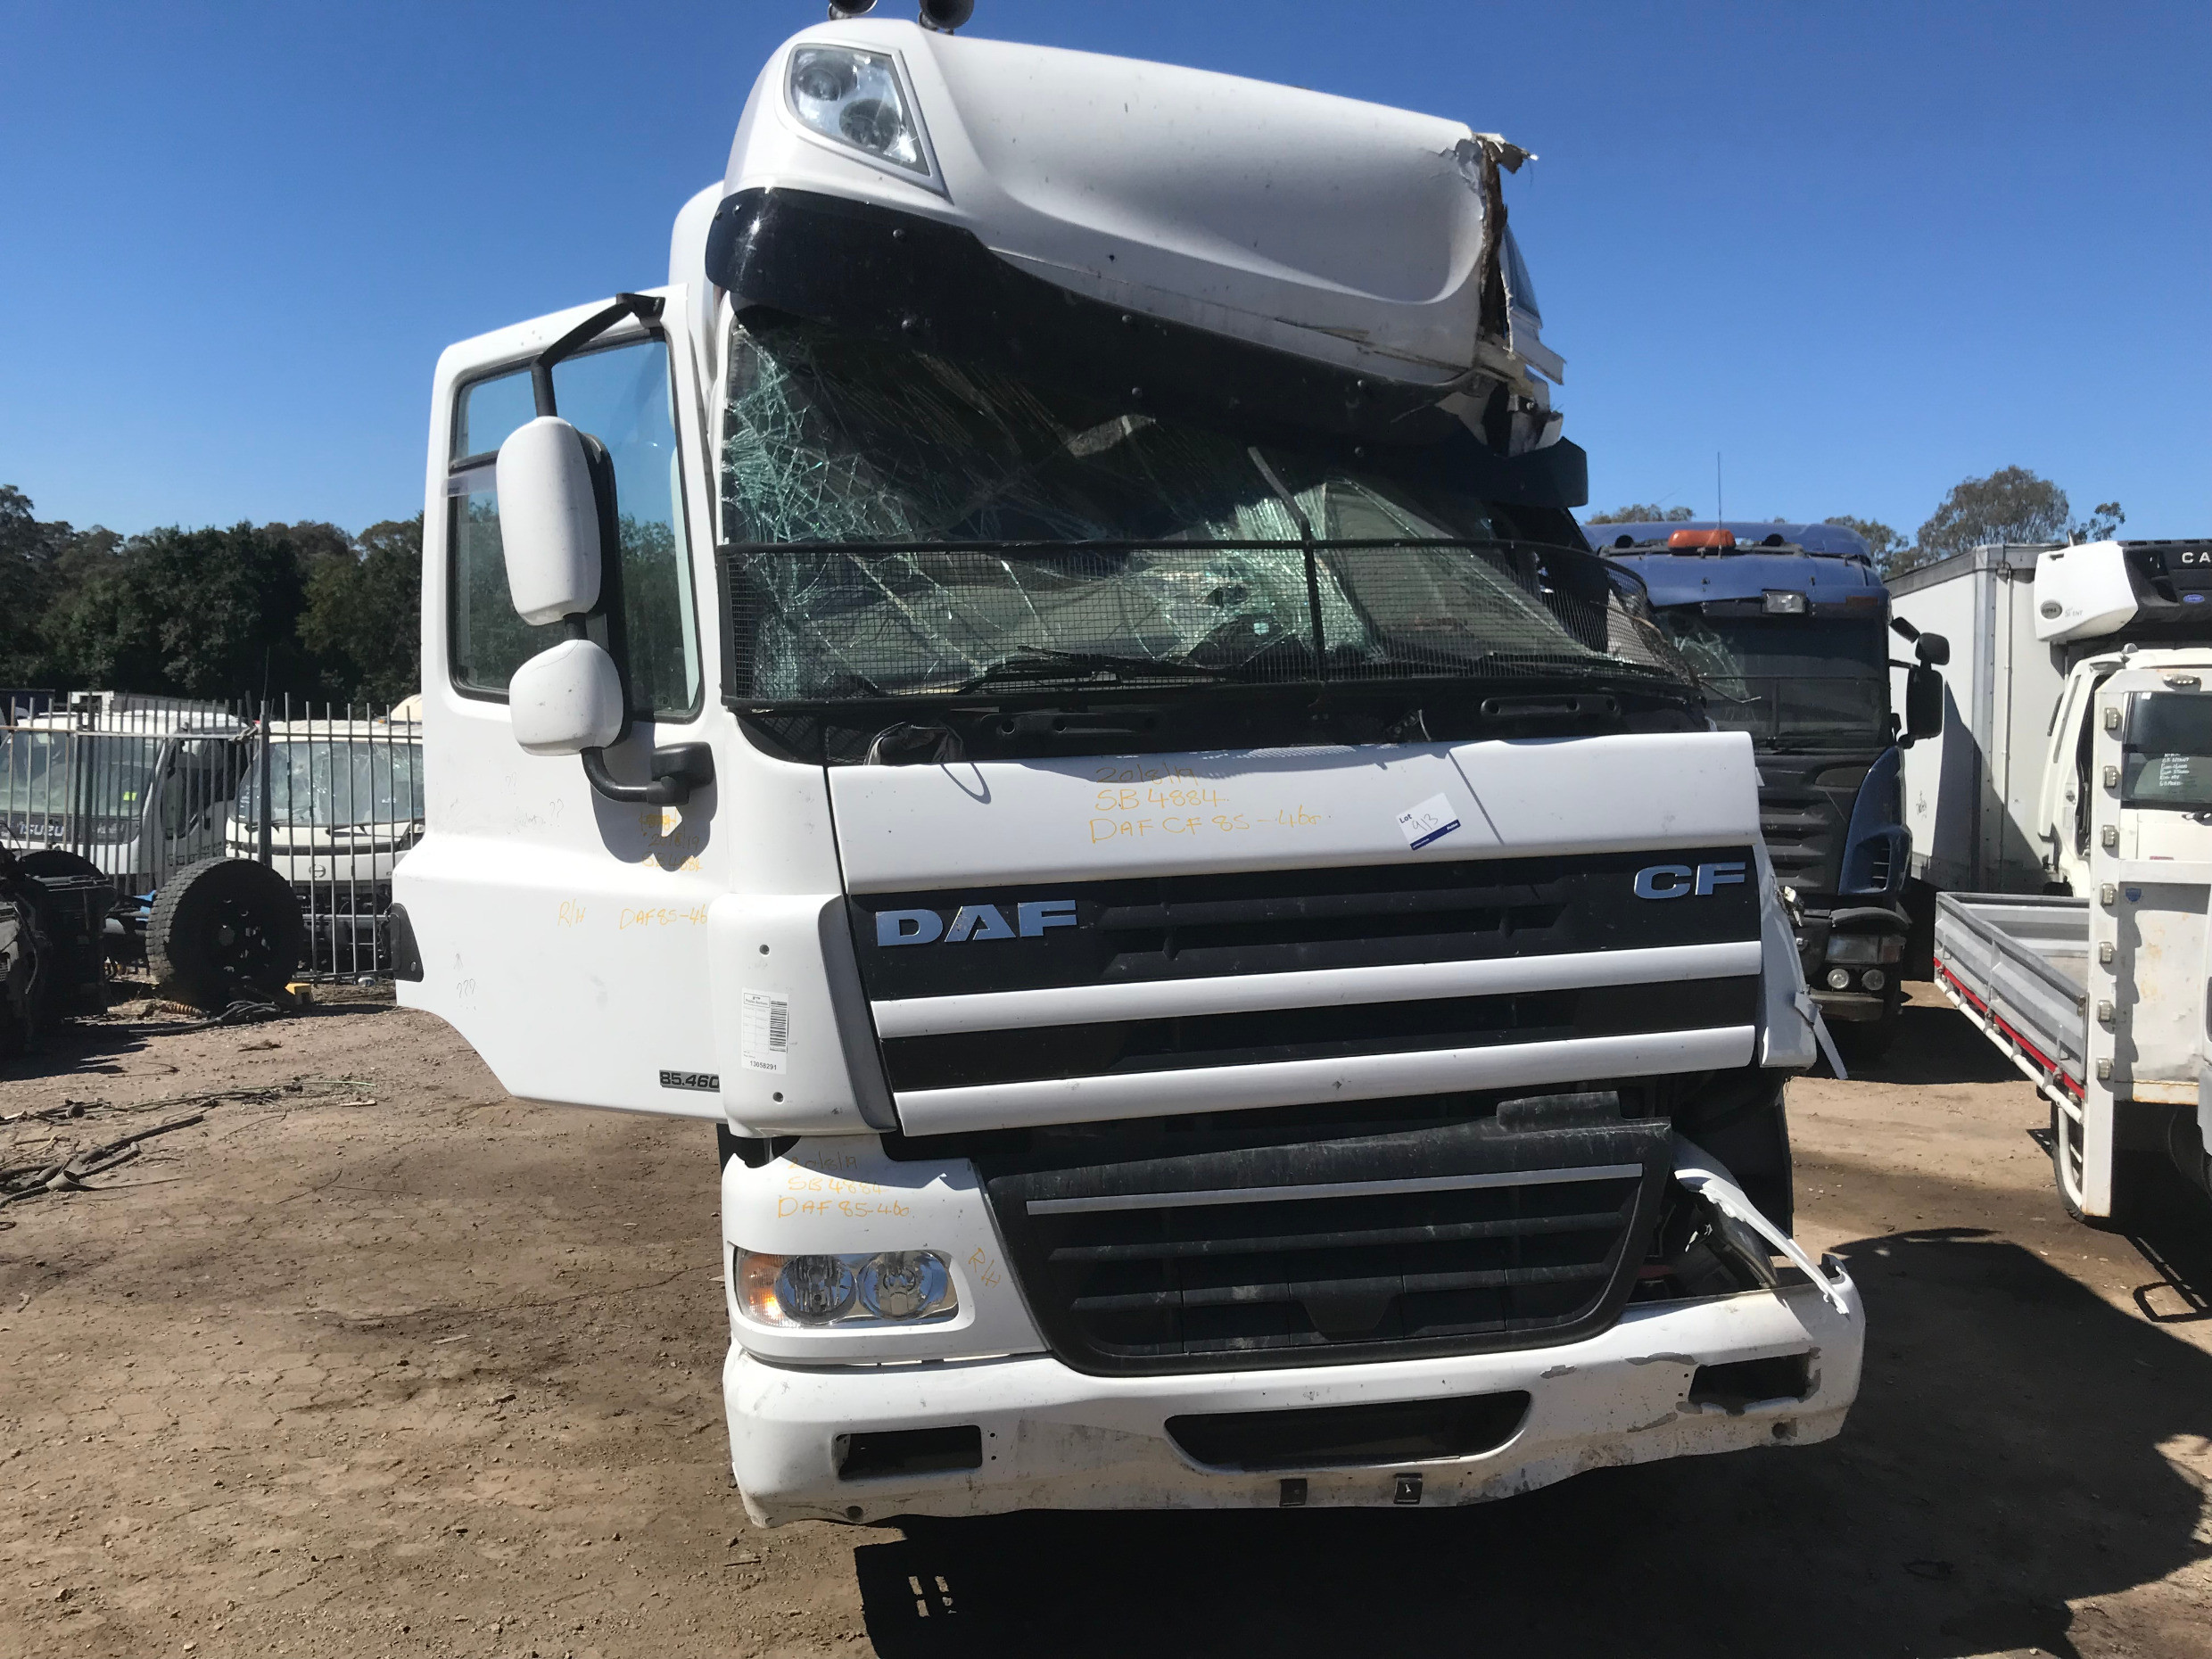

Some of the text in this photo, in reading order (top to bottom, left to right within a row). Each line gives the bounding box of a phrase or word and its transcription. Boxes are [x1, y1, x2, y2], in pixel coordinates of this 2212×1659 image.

[1094, 788, 1227, 811] SB 4884
[1399, 813, 1413, 824] Lot
[1412, 813, 1439, 831] 913
[1089, 818, 1154, 844] DAF
[1162, 817, 1202, 835] CF
[1633, 862, 1746, 900] CF
[875, 899, 1077, 947] DAF
[749, 1060, 777, 1070] 13058291
[660, 1071, 720, 1089] 85.460
[788, 1176, 889, 1195] SB 4884
[778, 1197, 833, 1218] DAF
